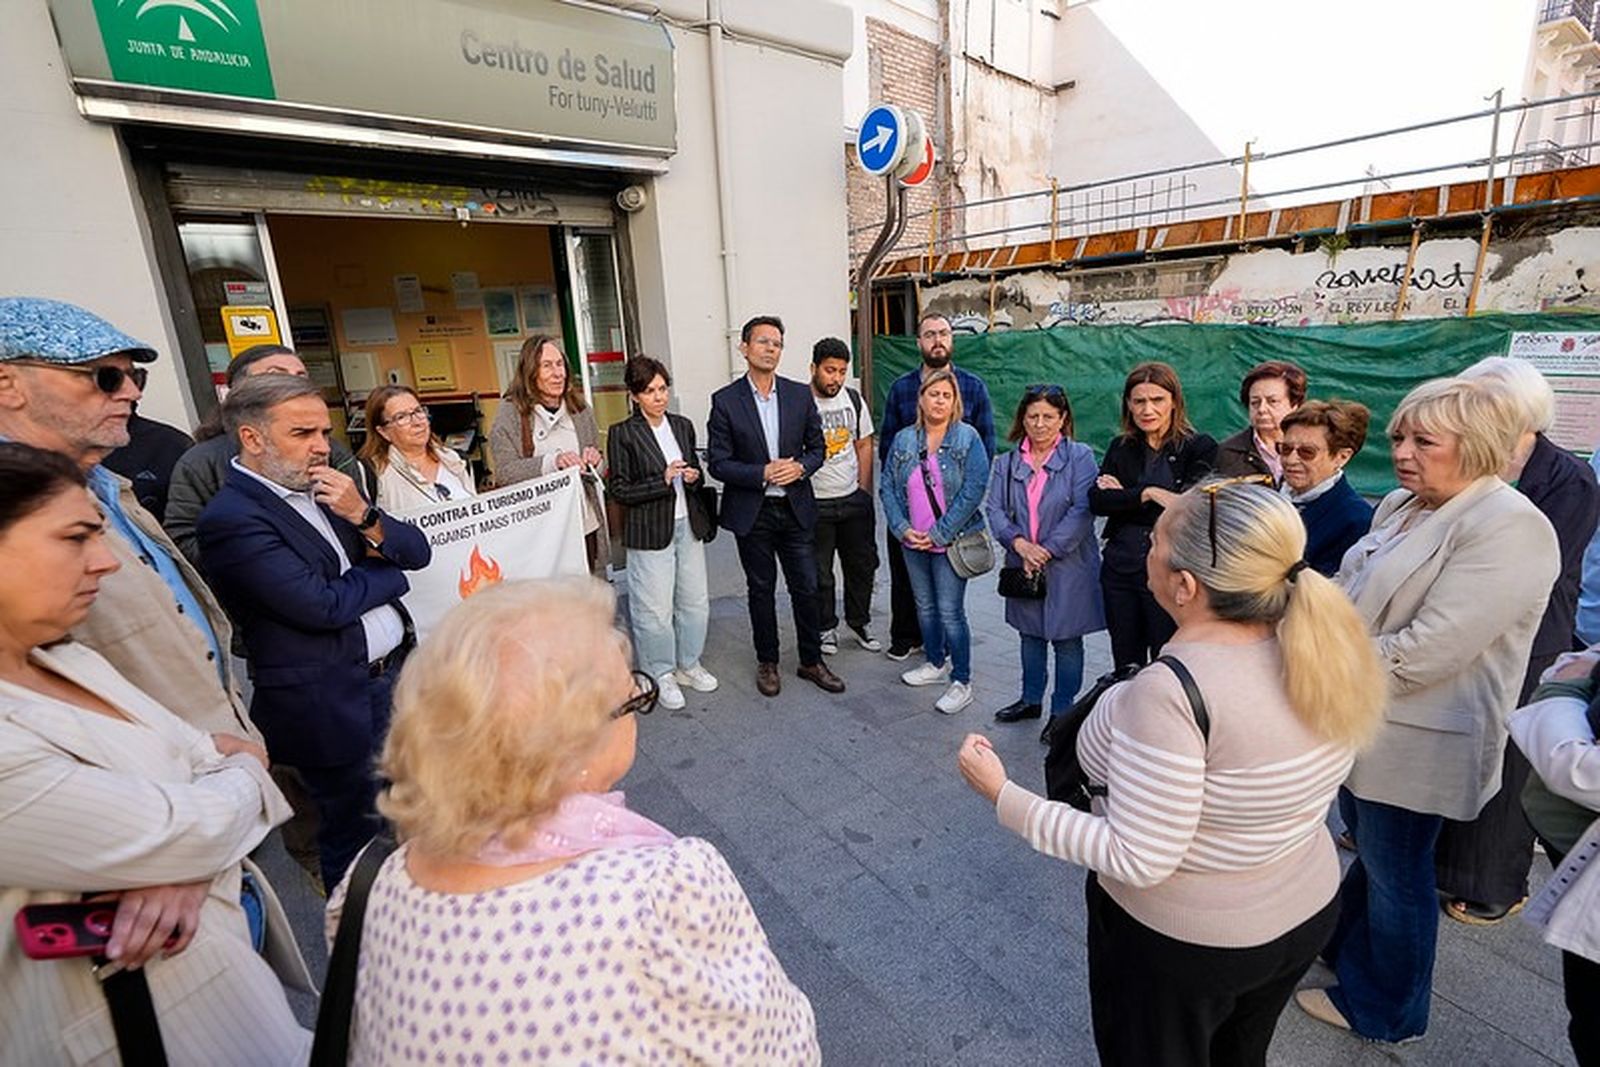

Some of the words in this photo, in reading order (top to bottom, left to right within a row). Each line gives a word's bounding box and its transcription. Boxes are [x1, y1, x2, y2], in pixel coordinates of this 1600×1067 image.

[127, 39, 167, 57] JUNTA
[169, 45, 186, 59] DE
[460, 29, 550, 77] Centro
[557, 48, 588, 83] de
[594, 54, 656, 94] Salud
[1328, 302, 1343, 314] EL
[1347, 301, 1372, 315] REY
[420, 506, 469, 529] CONTRA
[471, 502, 485, 516] EL
[487, 488, 534, 512] TURISMO
[535, 475, 571, 497] MASIVO
[430, 523, 477, 547] AGAINST
[479, 514, 510, 533] MASS
[510, 500, 552, 523] TOURISM
